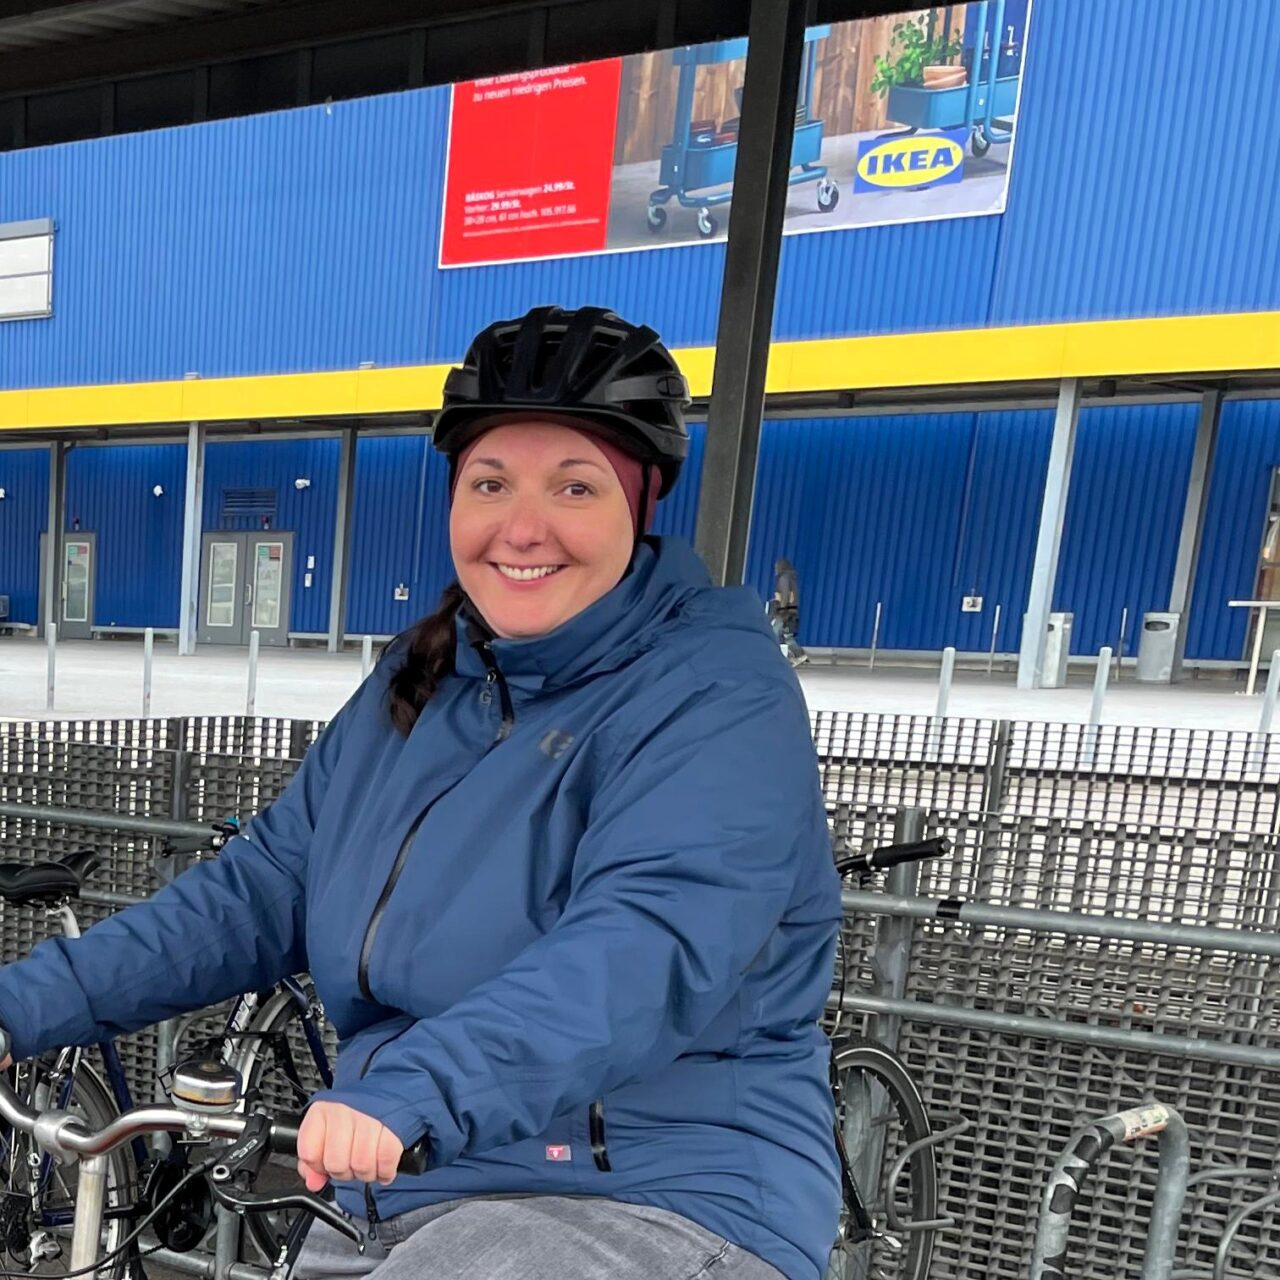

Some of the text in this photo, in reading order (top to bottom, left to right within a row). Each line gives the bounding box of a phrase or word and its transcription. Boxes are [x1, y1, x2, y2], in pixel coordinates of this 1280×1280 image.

[484, 88, 511, 101] neuen
[512, 82, 552, 96] niedrigen
[553, 76, 587, 89] Preisen.
[866, 147, 954, 176] IKEA
